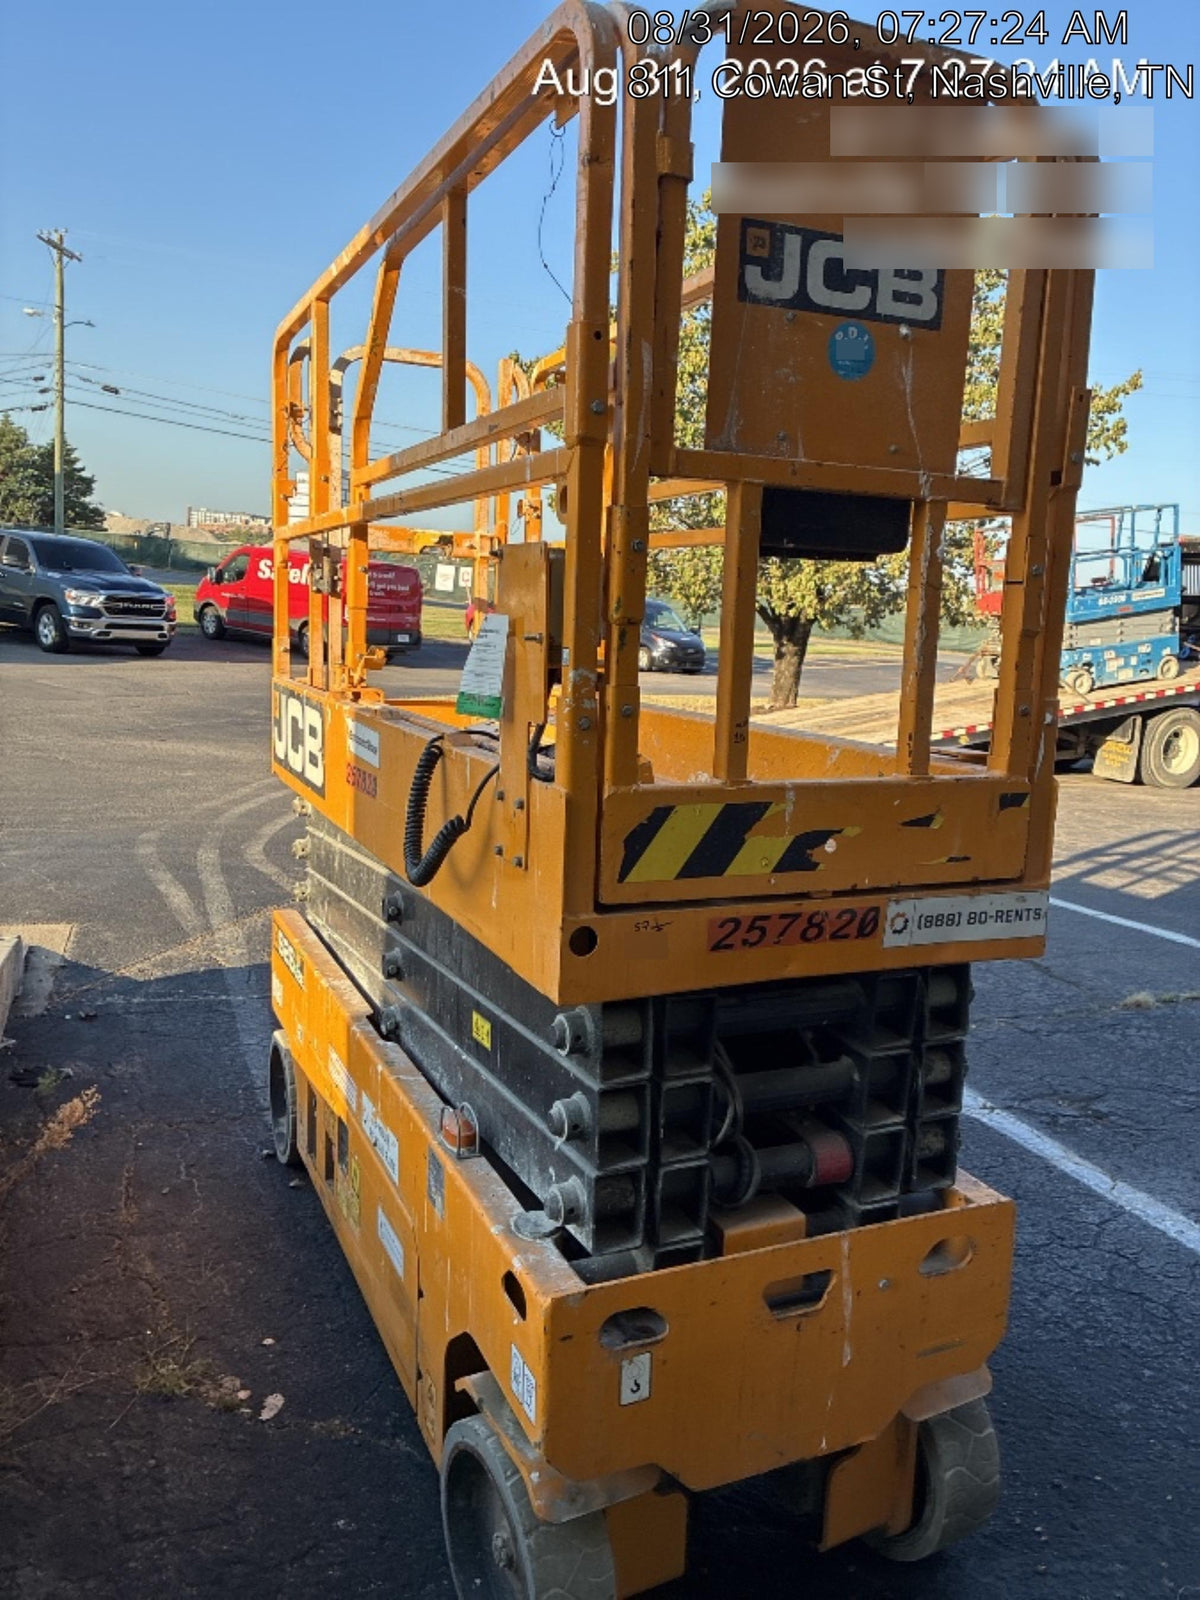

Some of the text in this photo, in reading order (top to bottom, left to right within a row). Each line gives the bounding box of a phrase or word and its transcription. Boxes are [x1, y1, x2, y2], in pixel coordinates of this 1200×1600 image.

[744, 232, 938, 321] JCB
[274, 692, 324, 788] JCB
[709, 905, 881, 952] 257820
[917, 907, 1042, 930] (888) 80-RENTS
